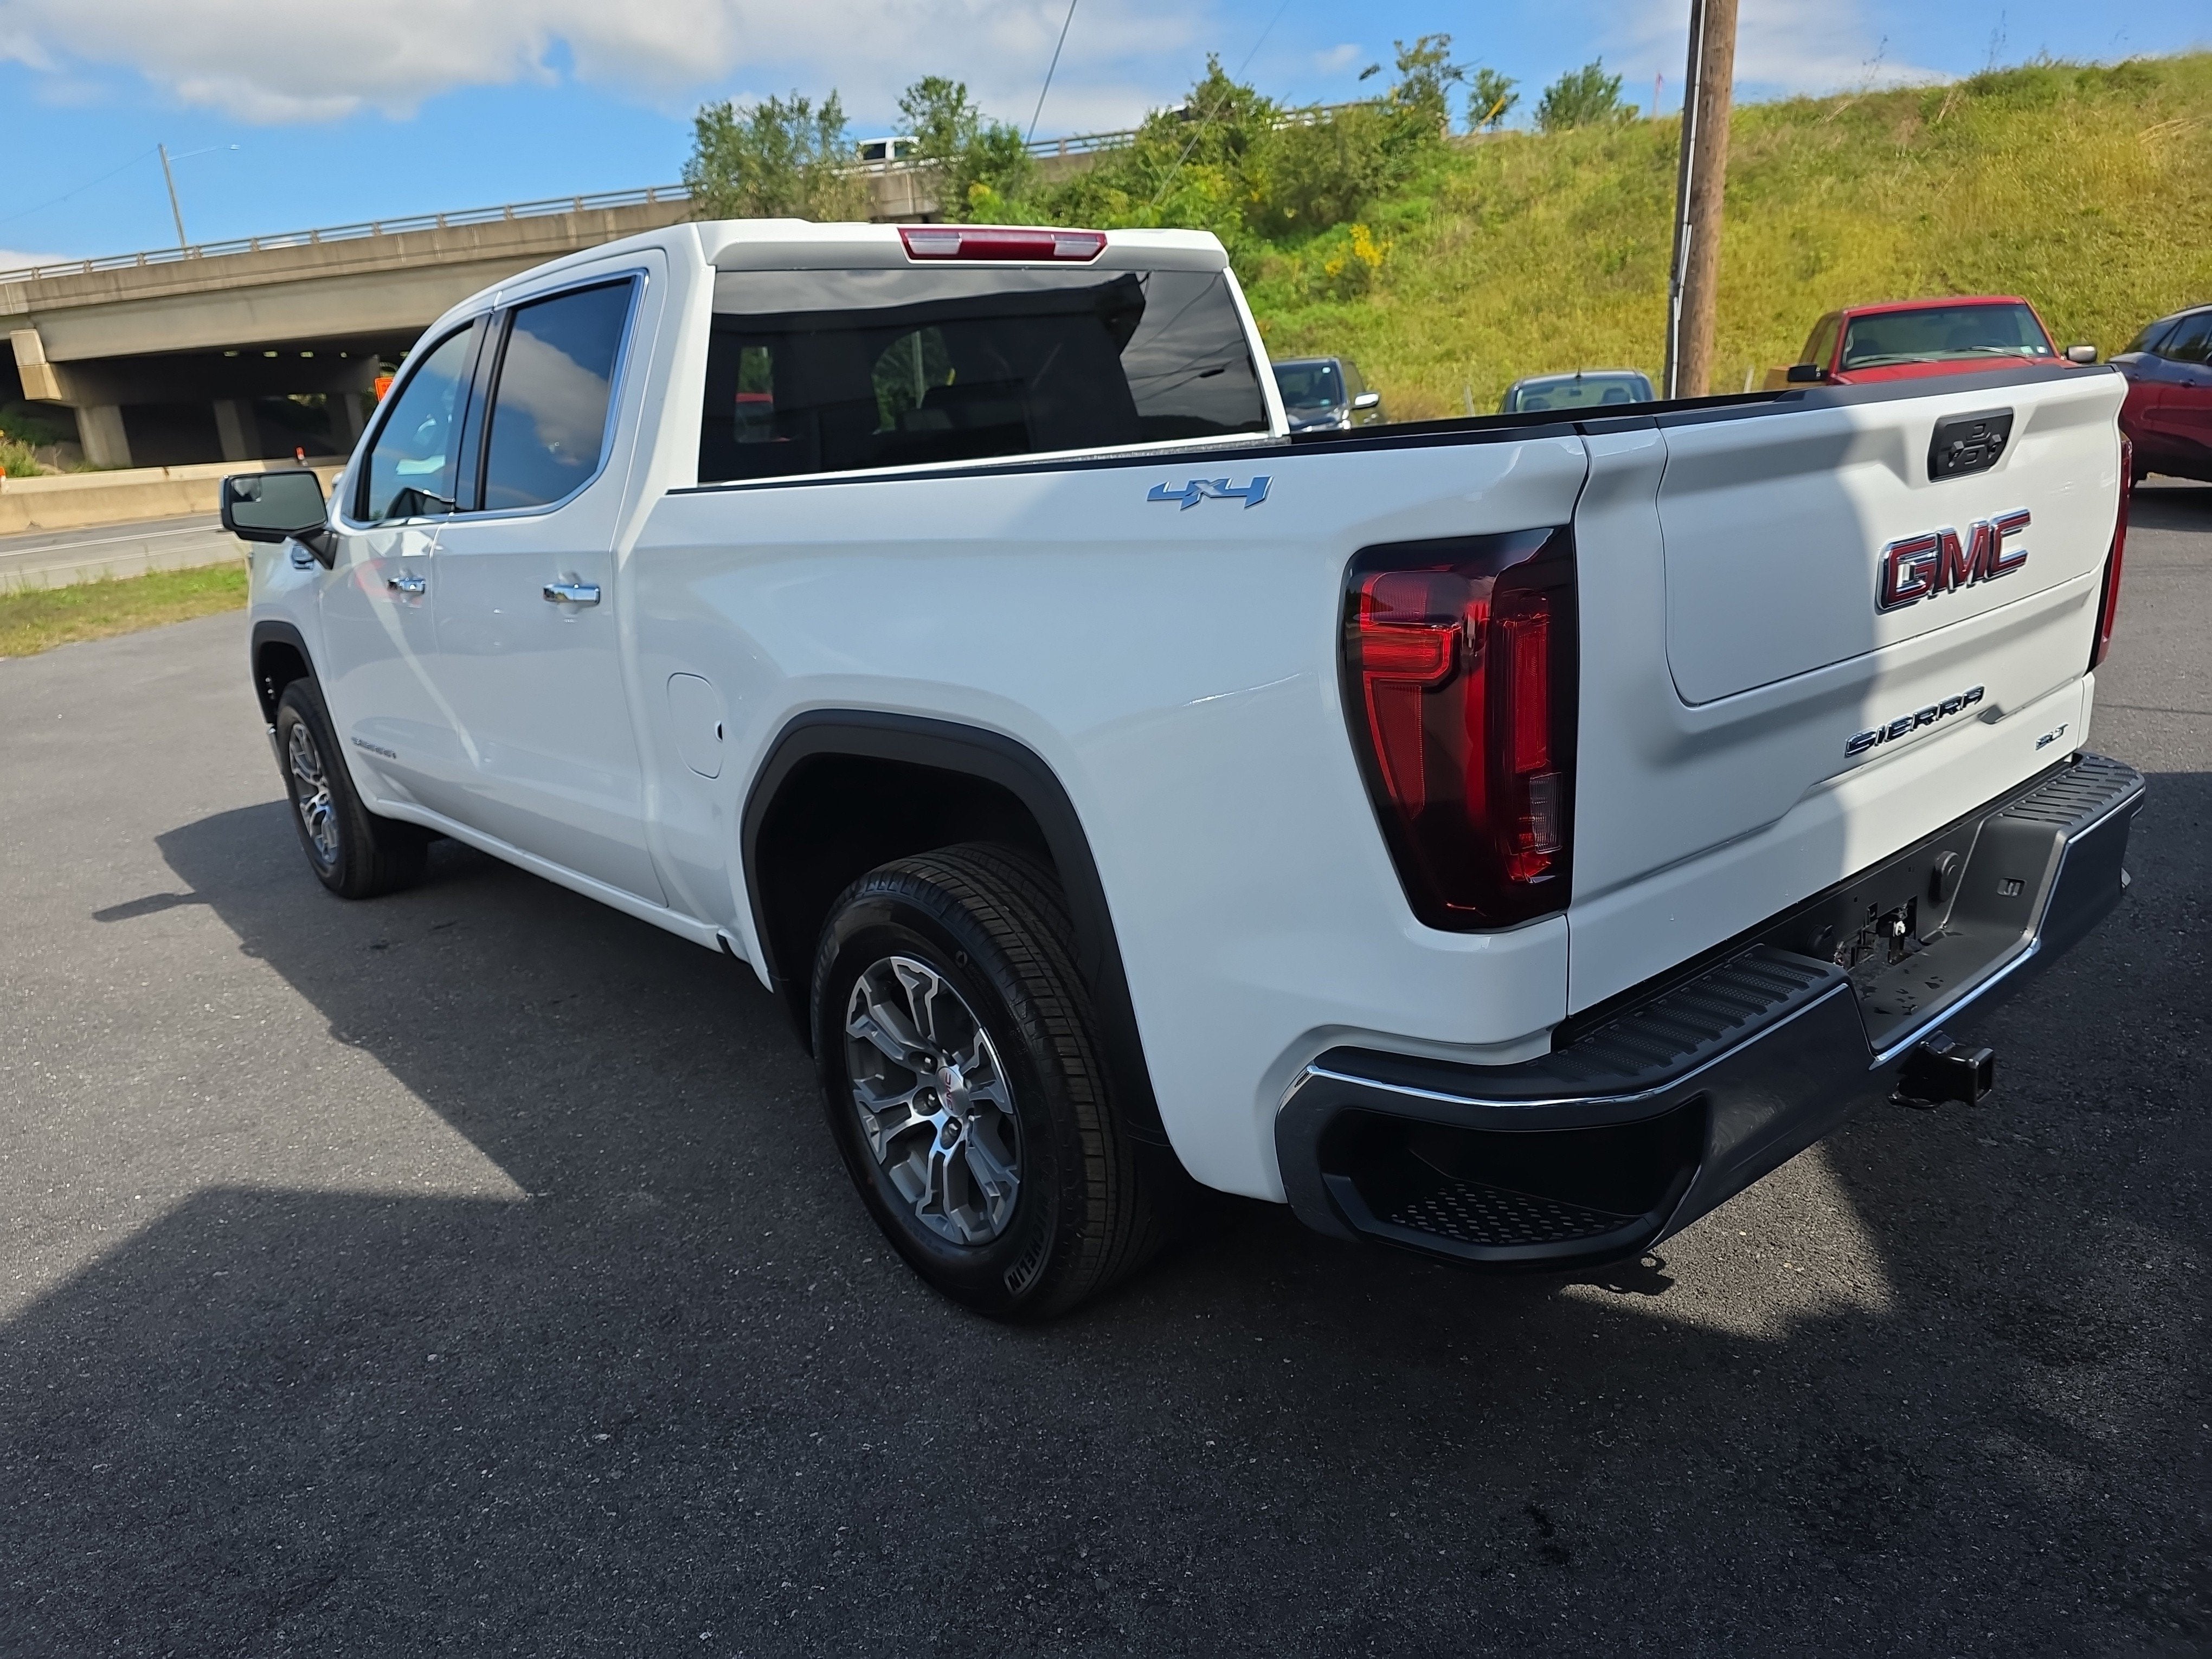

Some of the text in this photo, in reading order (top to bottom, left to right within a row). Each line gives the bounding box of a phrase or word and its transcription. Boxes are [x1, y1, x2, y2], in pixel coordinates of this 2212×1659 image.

[1876, 507, 2031, 612] GMC
[1845, 684, 1985, 758] SIERRA
[2035, 723, 2069, 750] SLT
[946, 1072, 954, 1110] GMC
